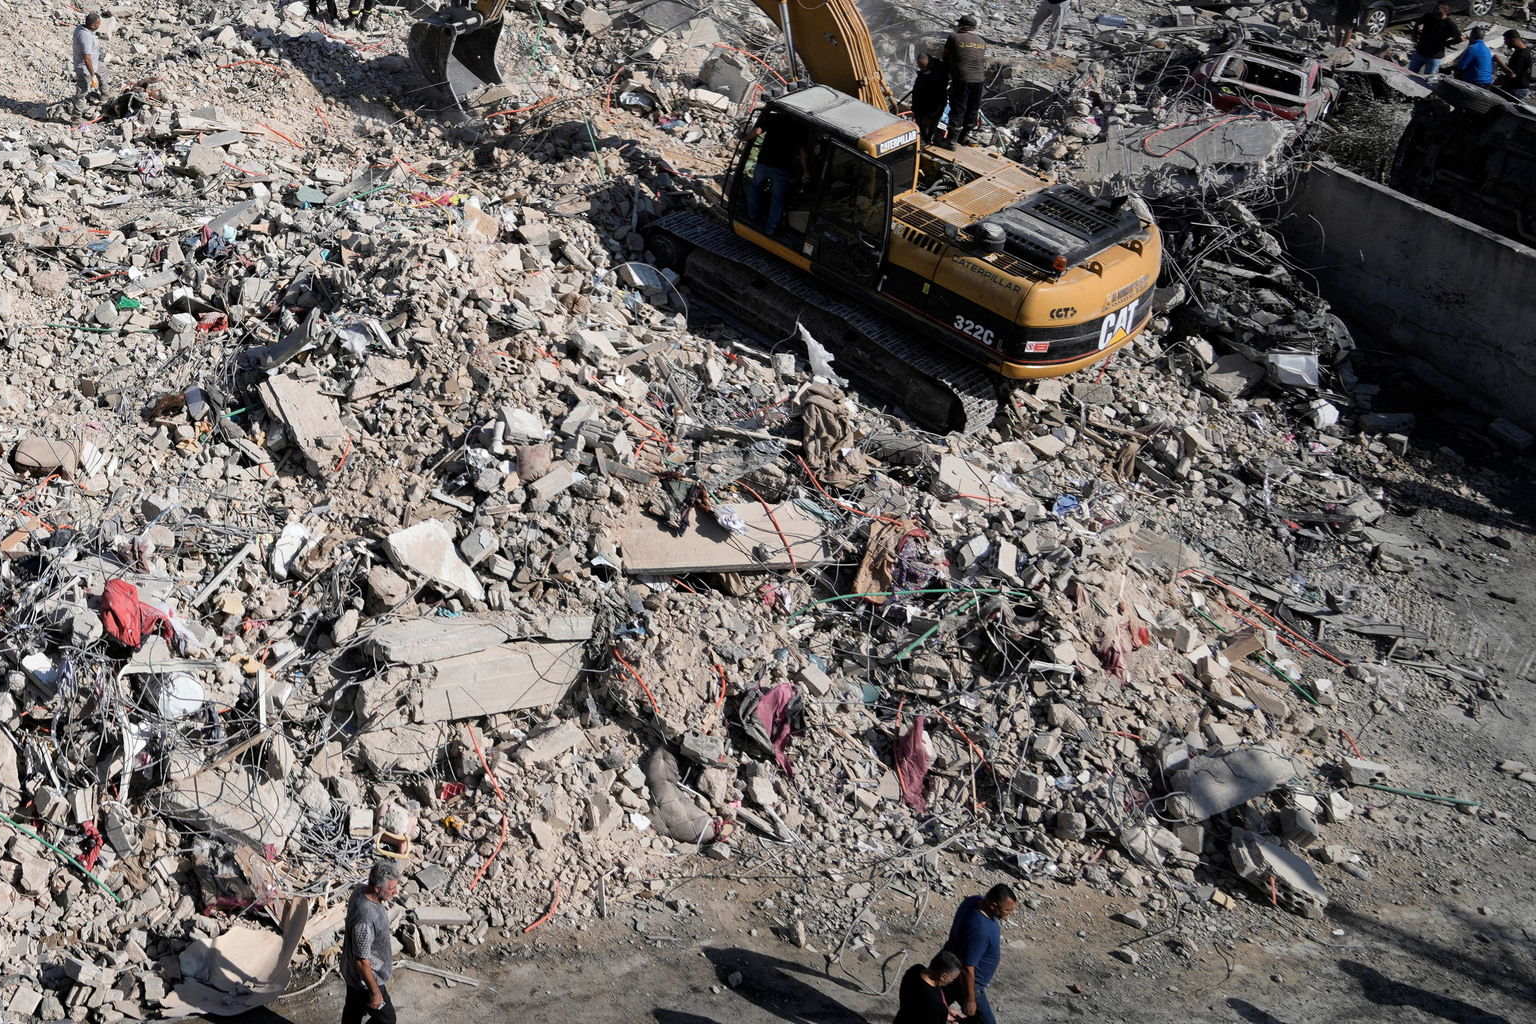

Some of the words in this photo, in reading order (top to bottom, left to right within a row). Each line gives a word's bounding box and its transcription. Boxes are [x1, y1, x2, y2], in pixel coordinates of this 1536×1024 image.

[880, 131, 917, 153] CATERPILLAR
[952, 255, 1021, 293] CATERPILLAR
[954, 315, 994, 345] 322C
[1099, 299, 1139, 350] CAT
